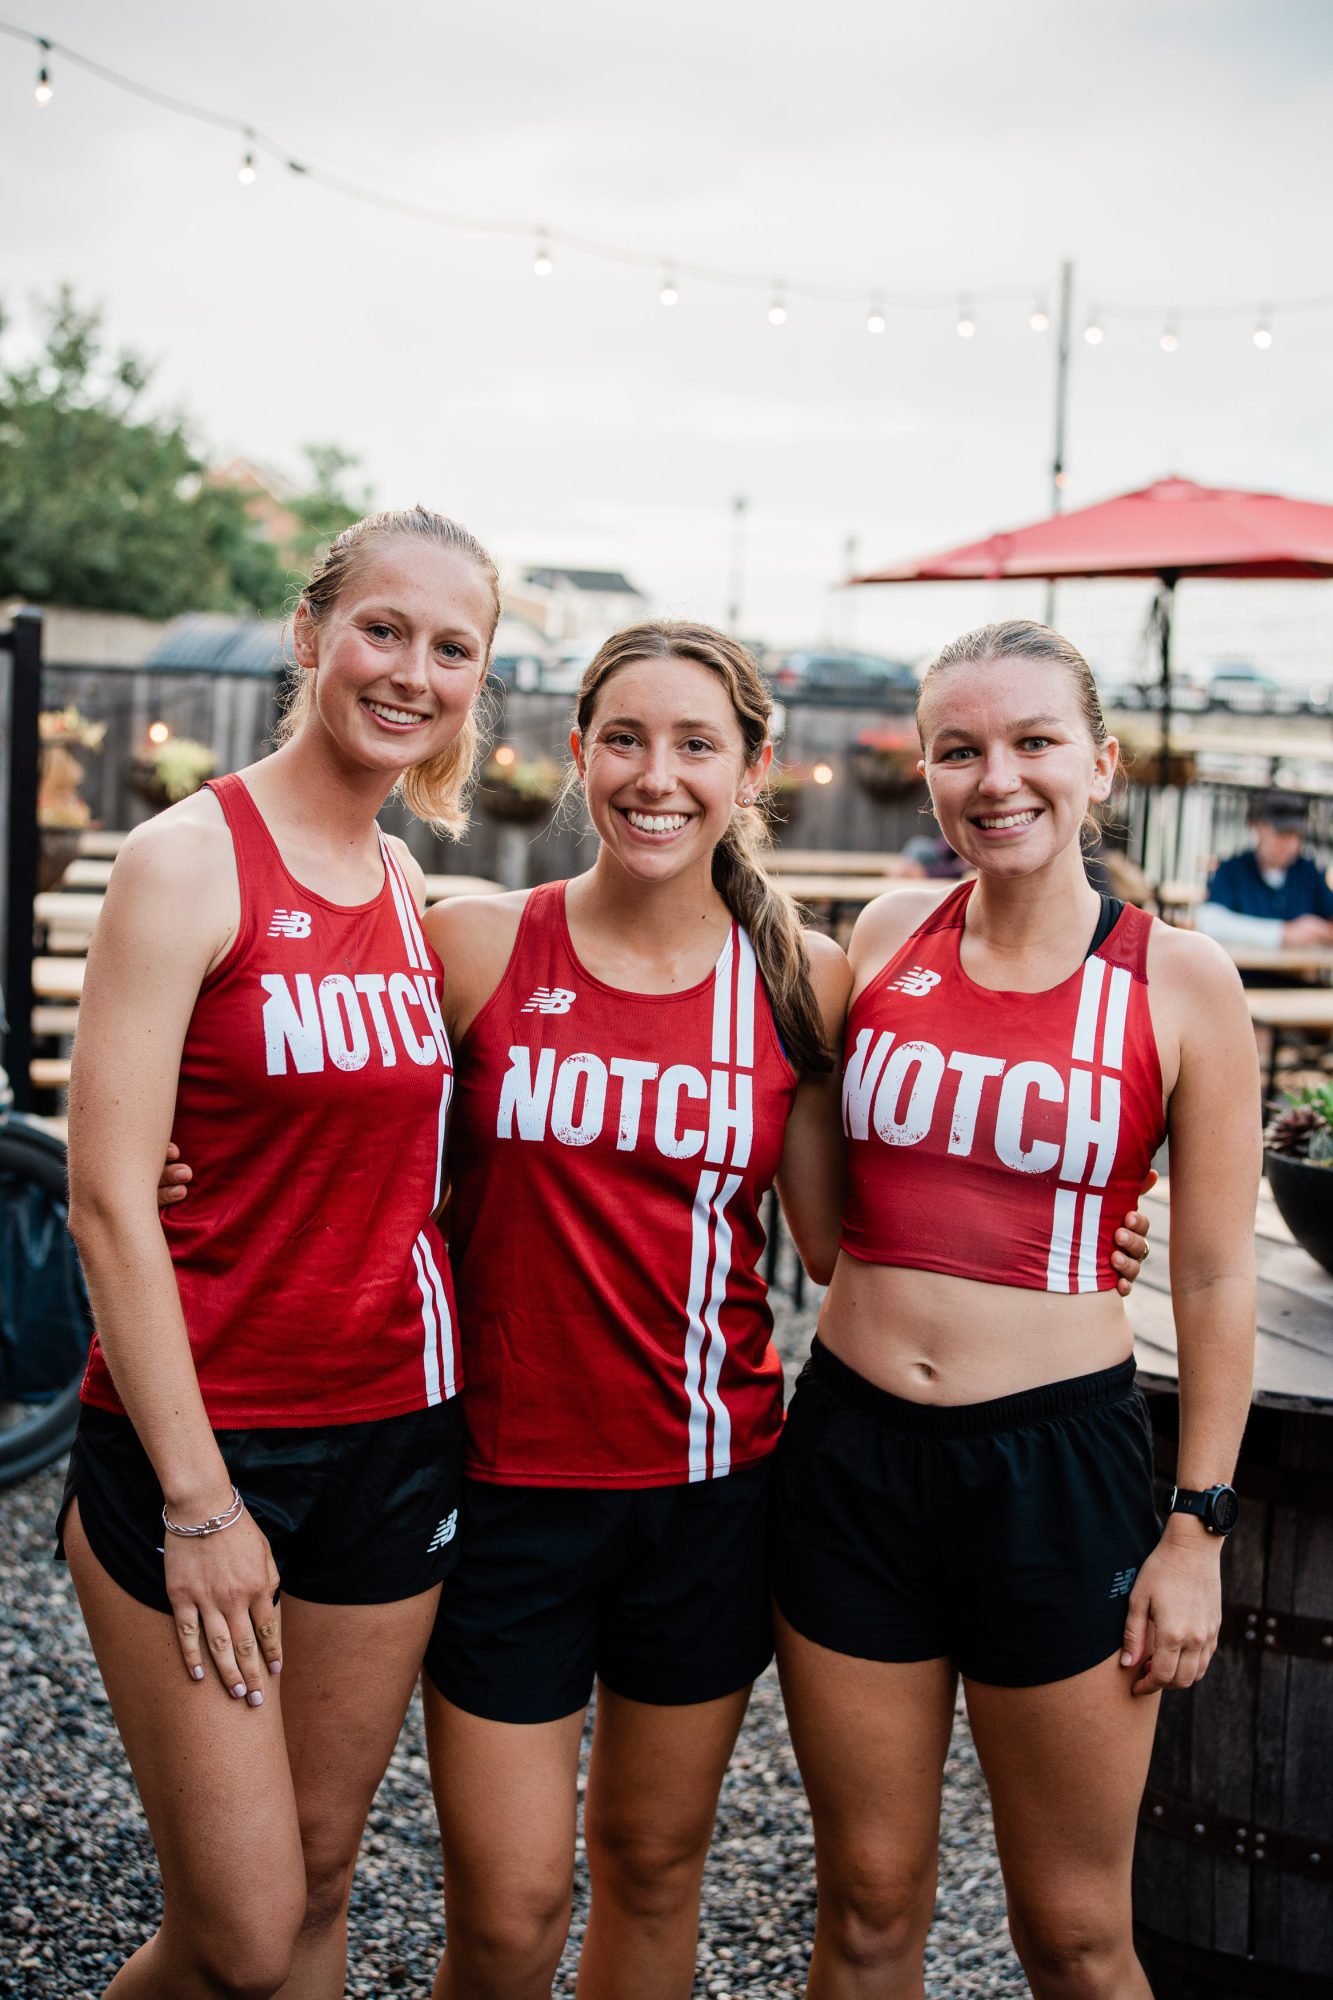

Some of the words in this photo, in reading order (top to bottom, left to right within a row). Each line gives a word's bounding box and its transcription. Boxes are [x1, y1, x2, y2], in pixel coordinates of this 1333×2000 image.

[267, 909, 312, 939] NB
[520, 986, 577, 1015] NB
[887, 966, 942, 997] NB
[260, 972, 454, 1076] NOTCH
[496, 1045, 754, 1169] NOTCH
[842, 1028, 1121, 1188] NOTCH
